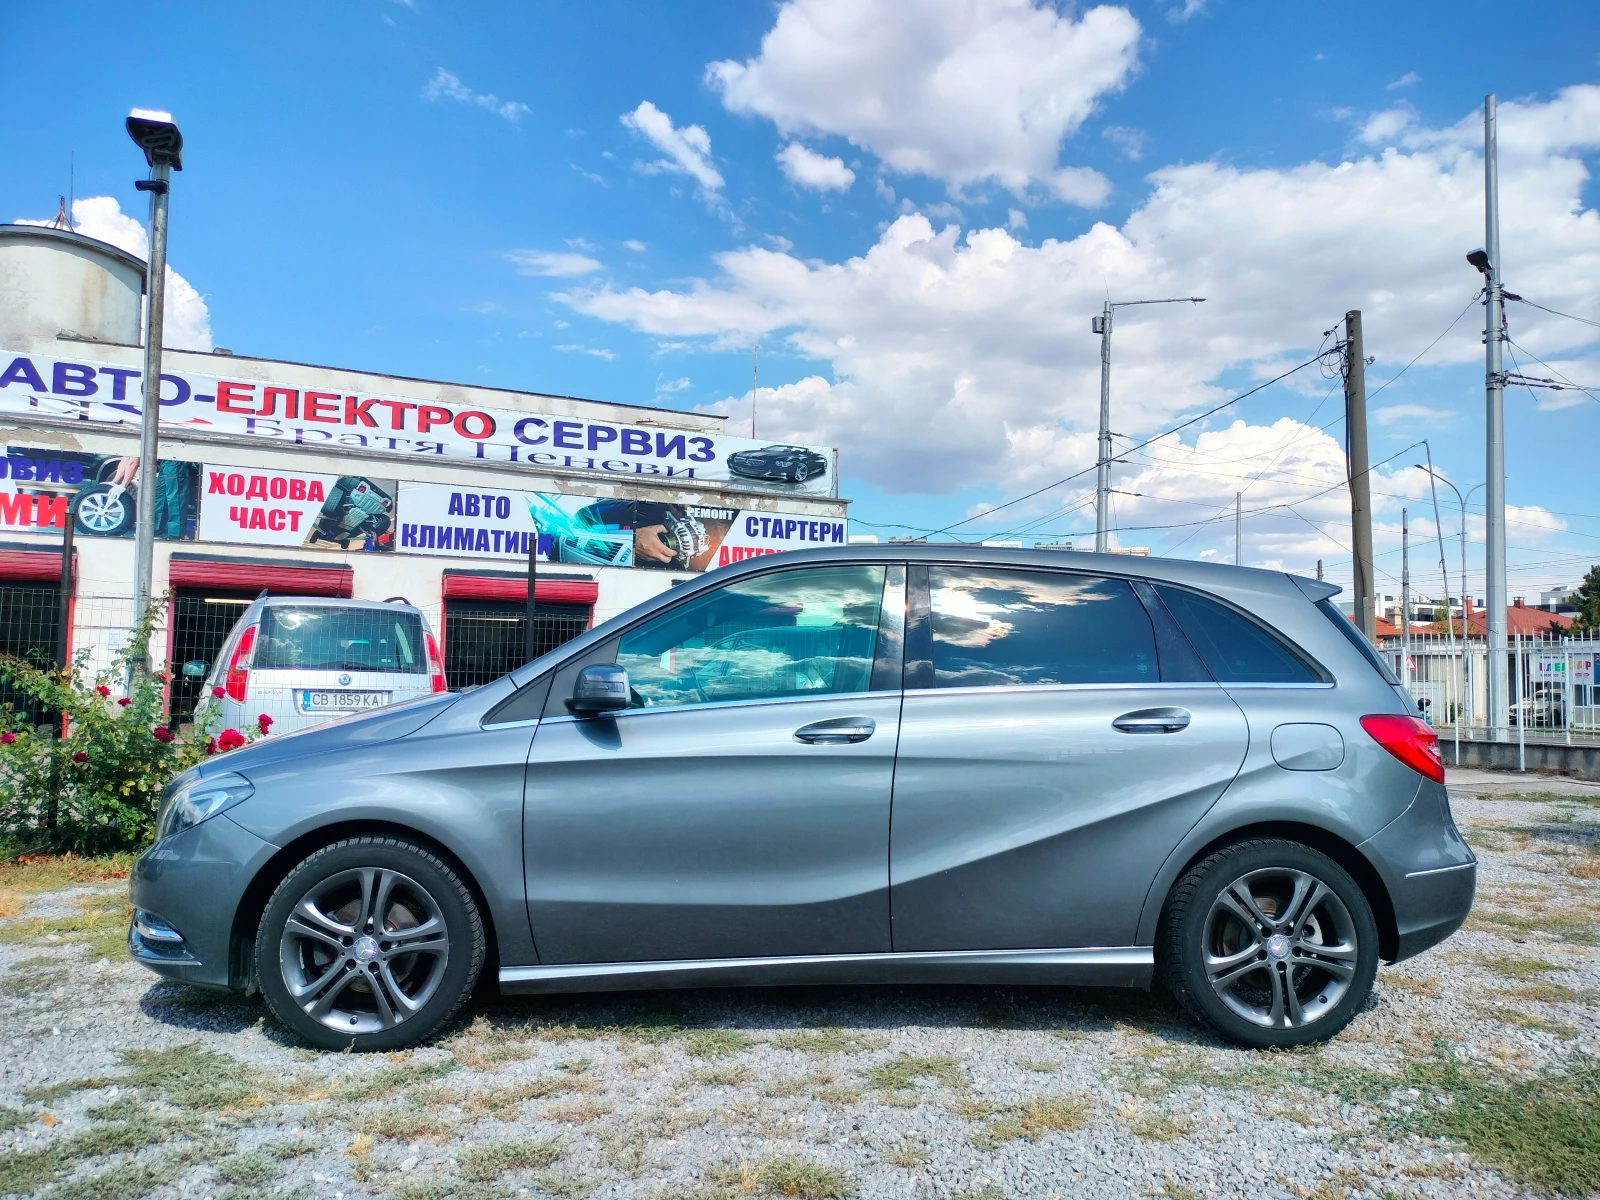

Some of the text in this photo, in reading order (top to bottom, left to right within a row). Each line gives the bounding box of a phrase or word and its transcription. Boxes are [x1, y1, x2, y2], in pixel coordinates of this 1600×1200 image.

[0, 357, 716, 463] АВТО-ЕЛЕКТРО СЕРВИЗ
[240, 417, 700, 479] Братя Пеневи
[208, 472, 325, 502] ХОДОВА
[229, 506, 304, 532] ЧАСТ
[448, 492, 511, 520] АВТО
[686, 507, 735, 521] РЕМОНТ
[745, 516, 844, 544] СТАРТЕРИ
[312, 694, 329, 706] CB
[333, 694, 361, 706] 1859
[363, 695, 380, 707] KA
